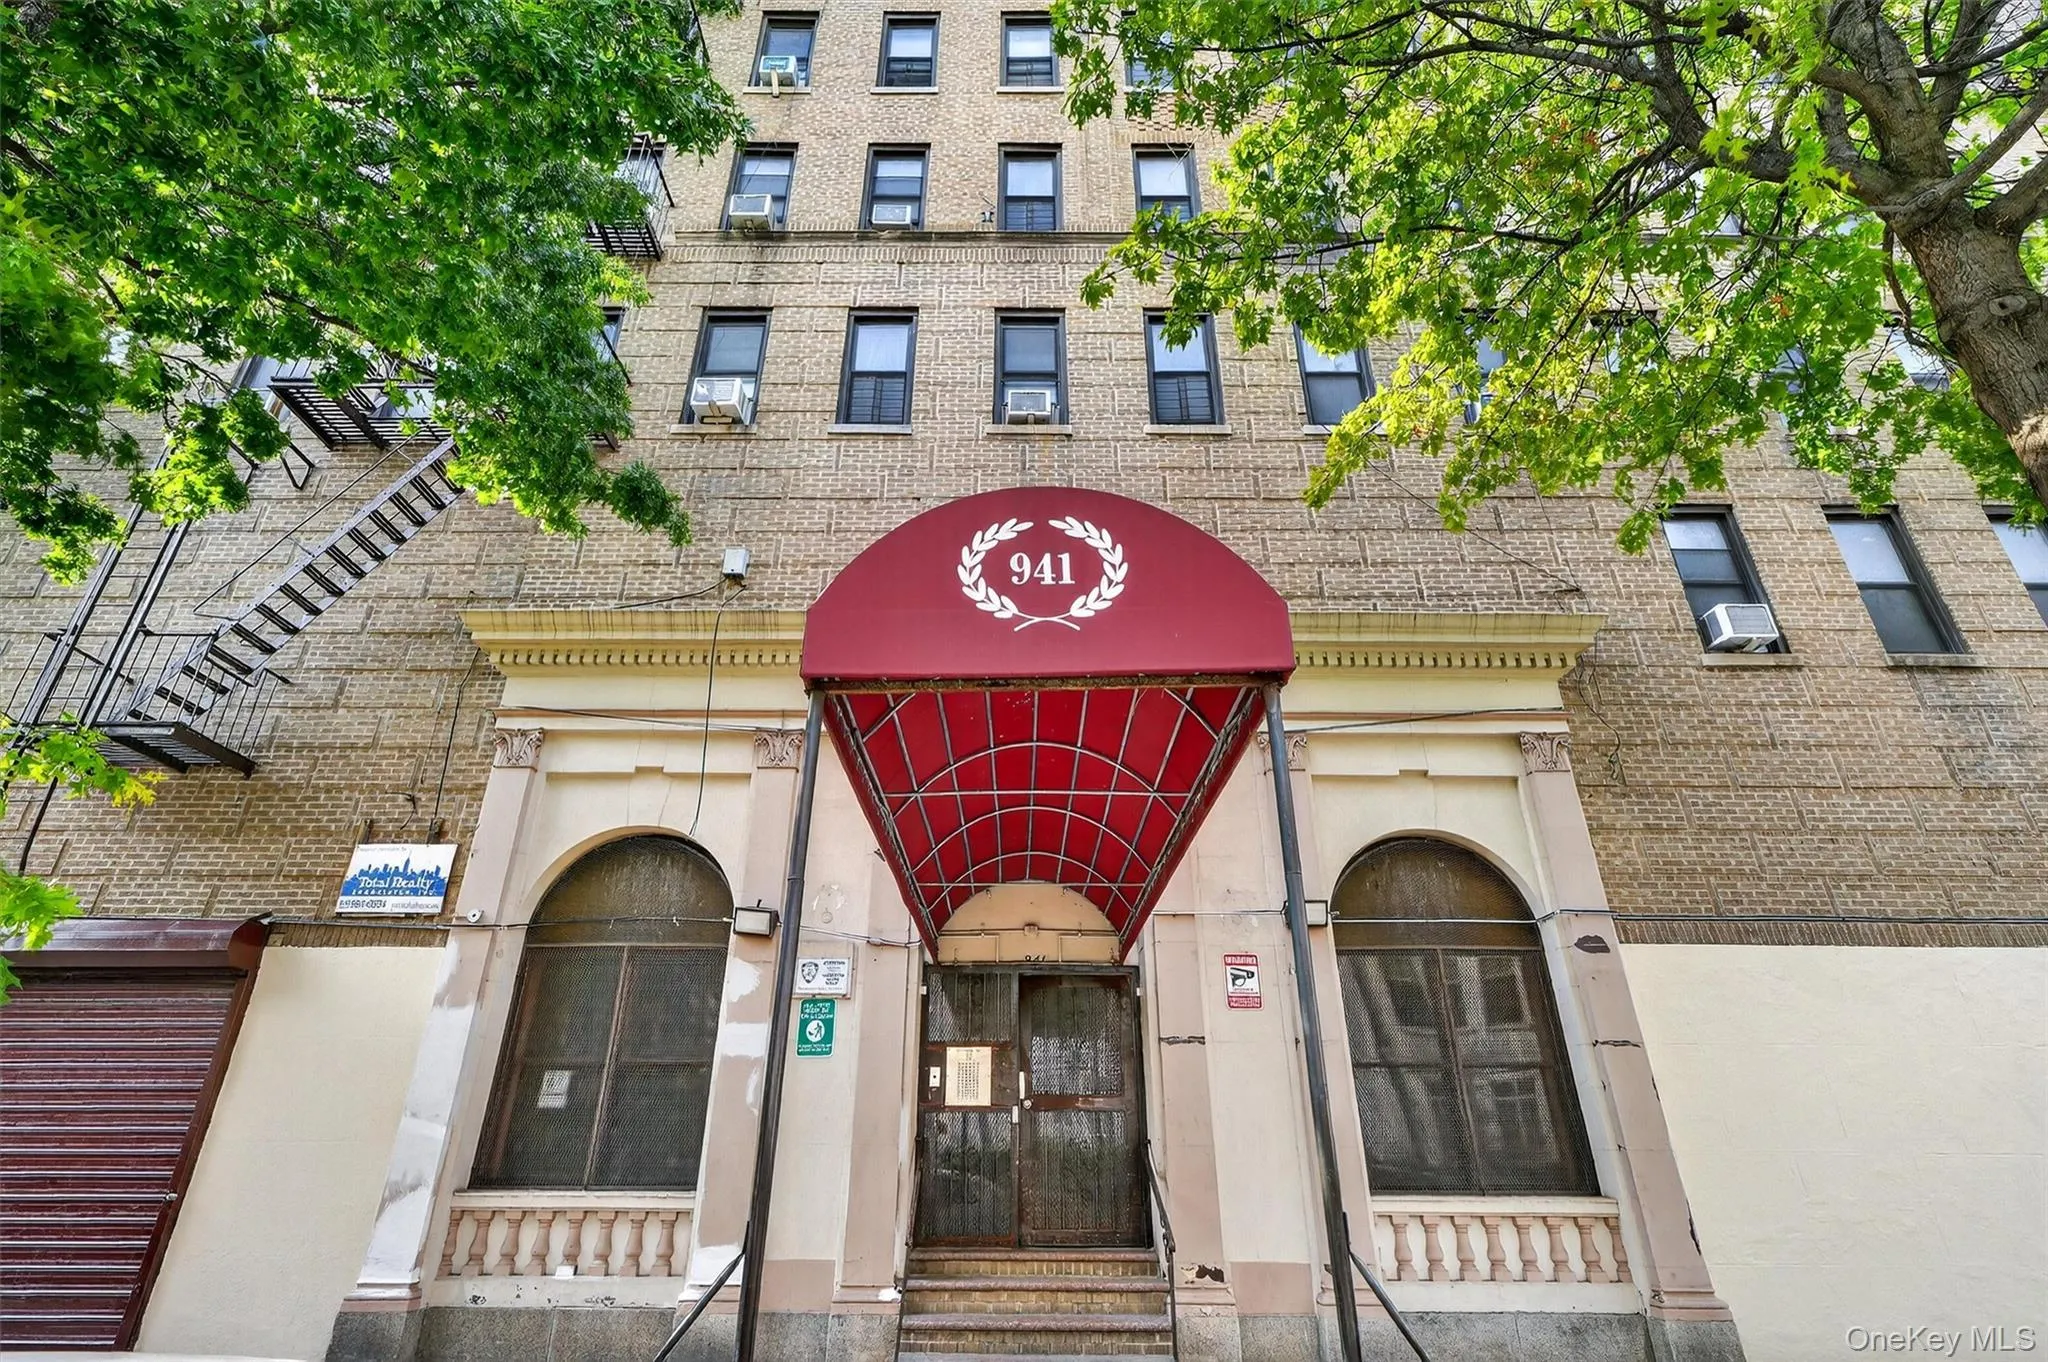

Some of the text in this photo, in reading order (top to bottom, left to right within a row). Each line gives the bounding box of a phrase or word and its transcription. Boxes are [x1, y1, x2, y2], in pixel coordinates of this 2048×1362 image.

[1009, 552, 1075, 585] 941
[359, 876, 389, 888] Total
[391, 876, 433, 892] Realty
